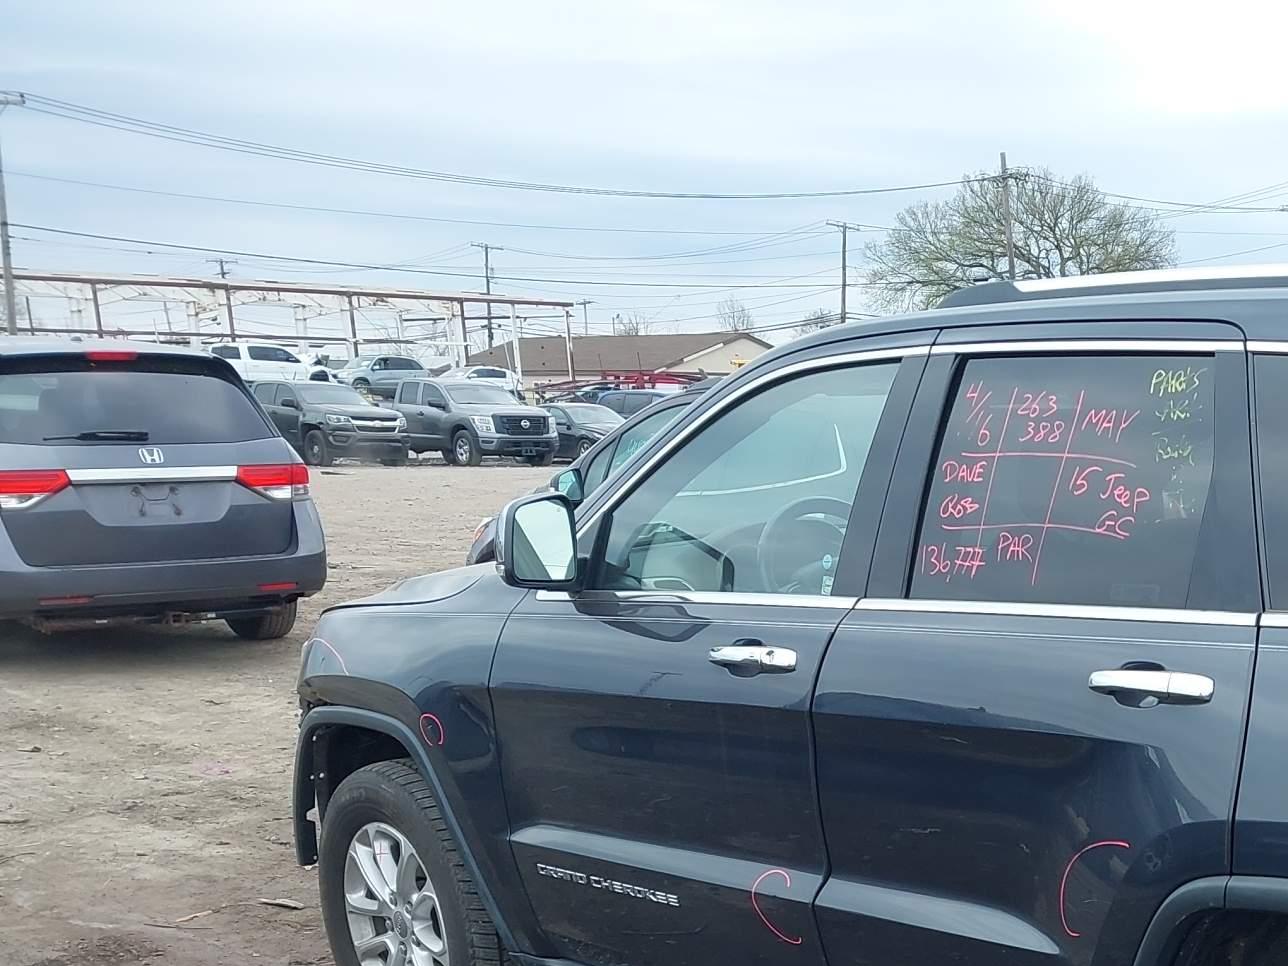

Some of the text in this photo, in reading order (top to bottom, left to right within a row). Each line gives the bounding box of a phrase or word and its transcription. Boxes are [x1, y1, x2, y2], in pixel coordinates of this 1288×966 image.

[1017, 392, 1057, 418] 263
[1018, 420, 1064, 443] 388
[1081, 409, 1140, 443] MAY
[942, 460, 987, 483] DAVE
[1069, 466, 1103, 495] 15
[998, 532, 1033, 562] PAR
[589, 875, 680, 907] CHEROKEE
